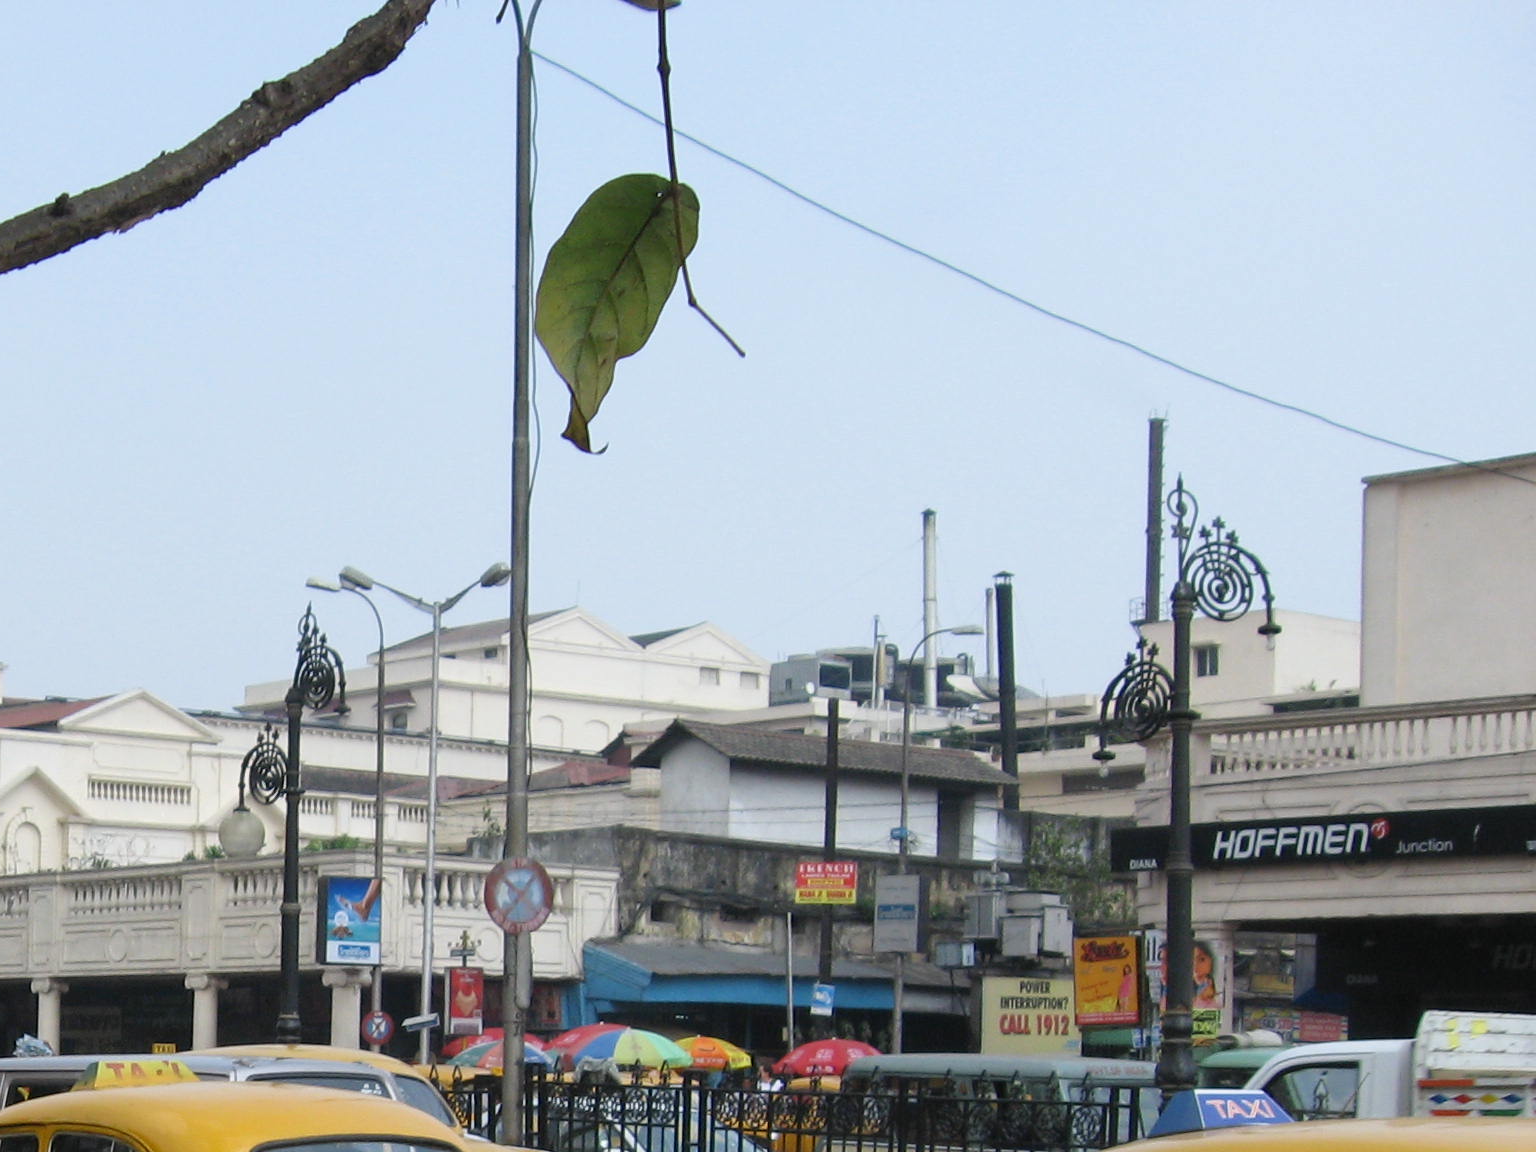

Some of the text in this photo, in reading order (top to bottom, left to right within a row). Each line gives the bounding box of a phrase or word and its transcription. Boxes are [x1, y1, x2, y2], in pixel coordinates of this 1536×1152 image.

[1213, 823, 1453, 860] HOFFMEN Junction
[1129, 858, 1158, 870] DIANA
[1019, 980, 1051, 994] POWER
[1000, 996, 1069, 1010] INTERRUPTION?
[999, 1013, 1031, 1035] CALL
[1036, 1013, 1070, 1036] 1912
[1205, 1098, 1277, 1120] TAXI
